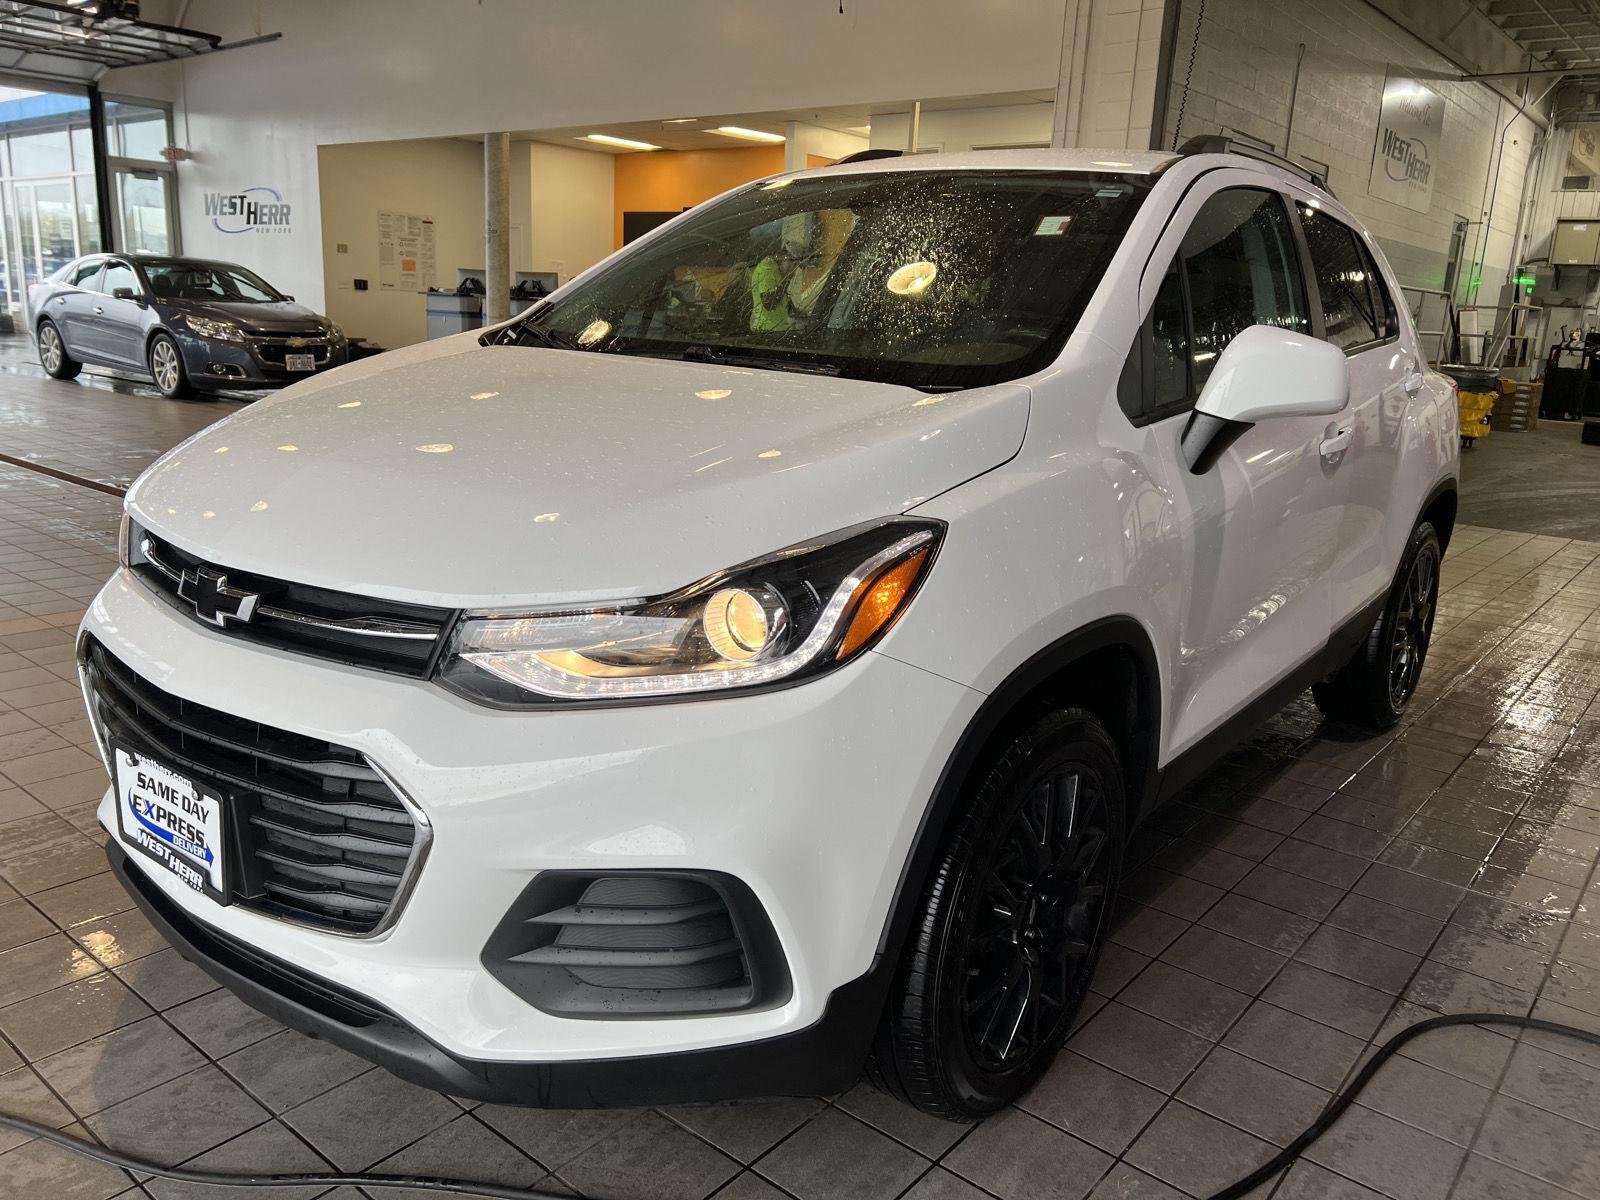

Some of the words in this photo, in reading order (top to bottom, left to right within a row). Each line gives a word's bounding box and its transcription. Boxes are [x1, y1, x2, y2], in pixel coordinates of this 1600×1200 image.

[1382, 128, 1411, 164] WEST
[1405, 151, 1431, 185] HERR
[203, 193, 247, 216] WEST
[246, 201, 291, 225] HERR
[133, 793, 206, 848] EXPRESS
[137, 771, 178, 806] SAME
[182, 796, 210, 825] DAY
[136, 828, 172, 861] WEST
[169, 854, 204, 888] HERR
[172, 834, 207, 859] DELIVERY
